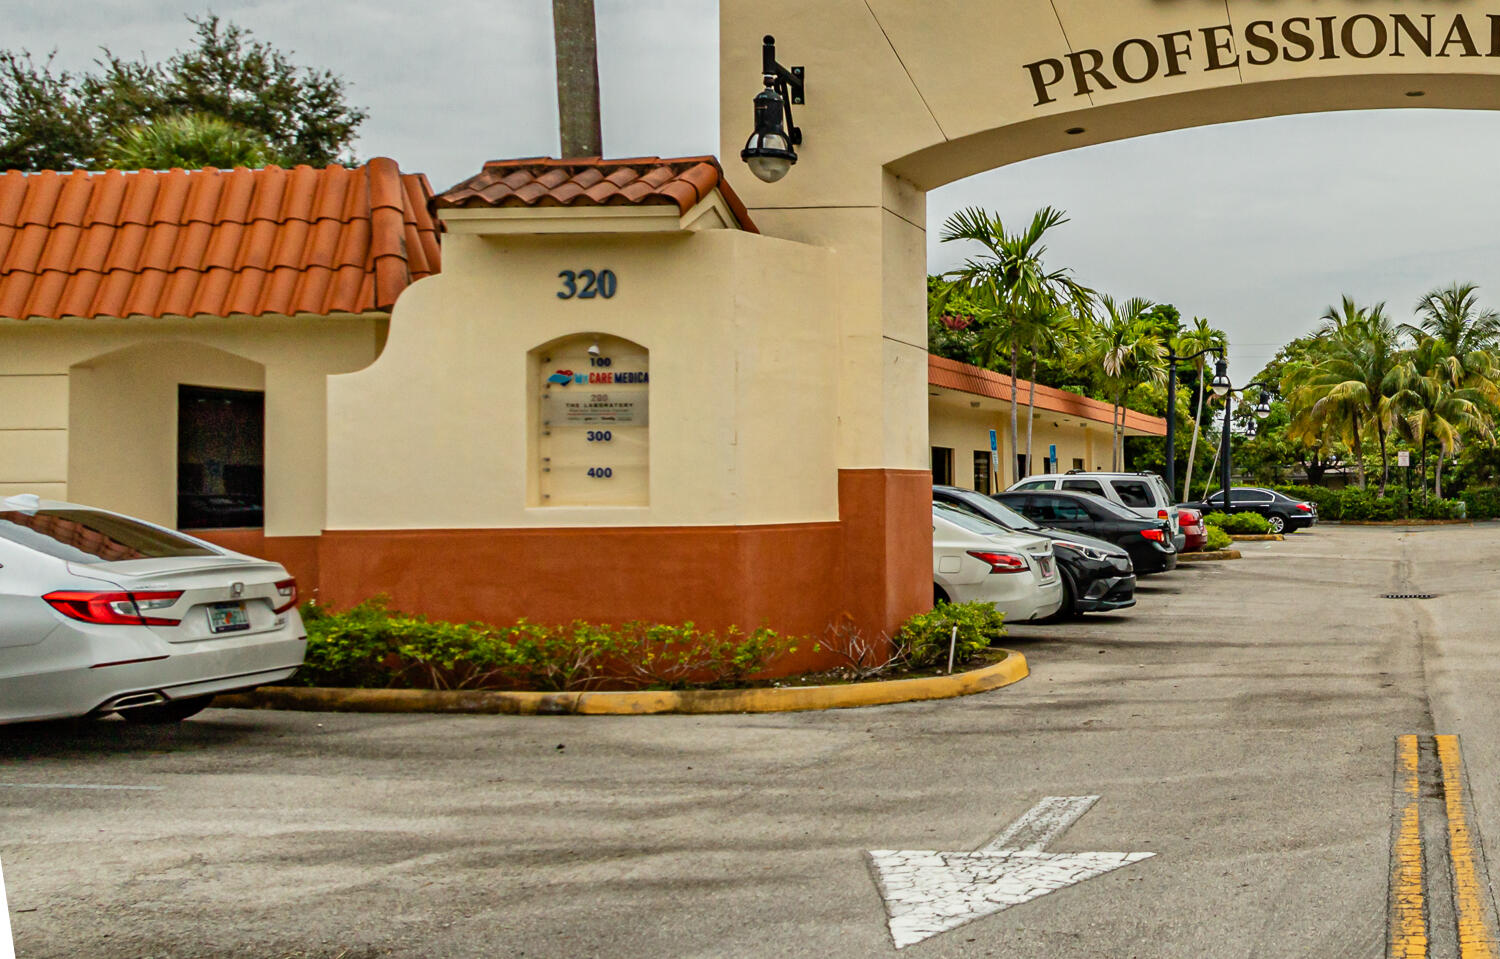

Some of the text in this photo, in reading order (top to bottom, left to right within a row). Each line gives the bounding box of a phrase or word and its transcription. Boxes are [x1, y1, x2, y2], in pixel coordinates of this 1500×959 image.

[556, 268, 618, 300] 320
[590, 357, 612, 367] 100
[614, 372, 649, 384] MEDICA
[586, 430, 612, 442] 300
[587, 467, 613, 478] 400
